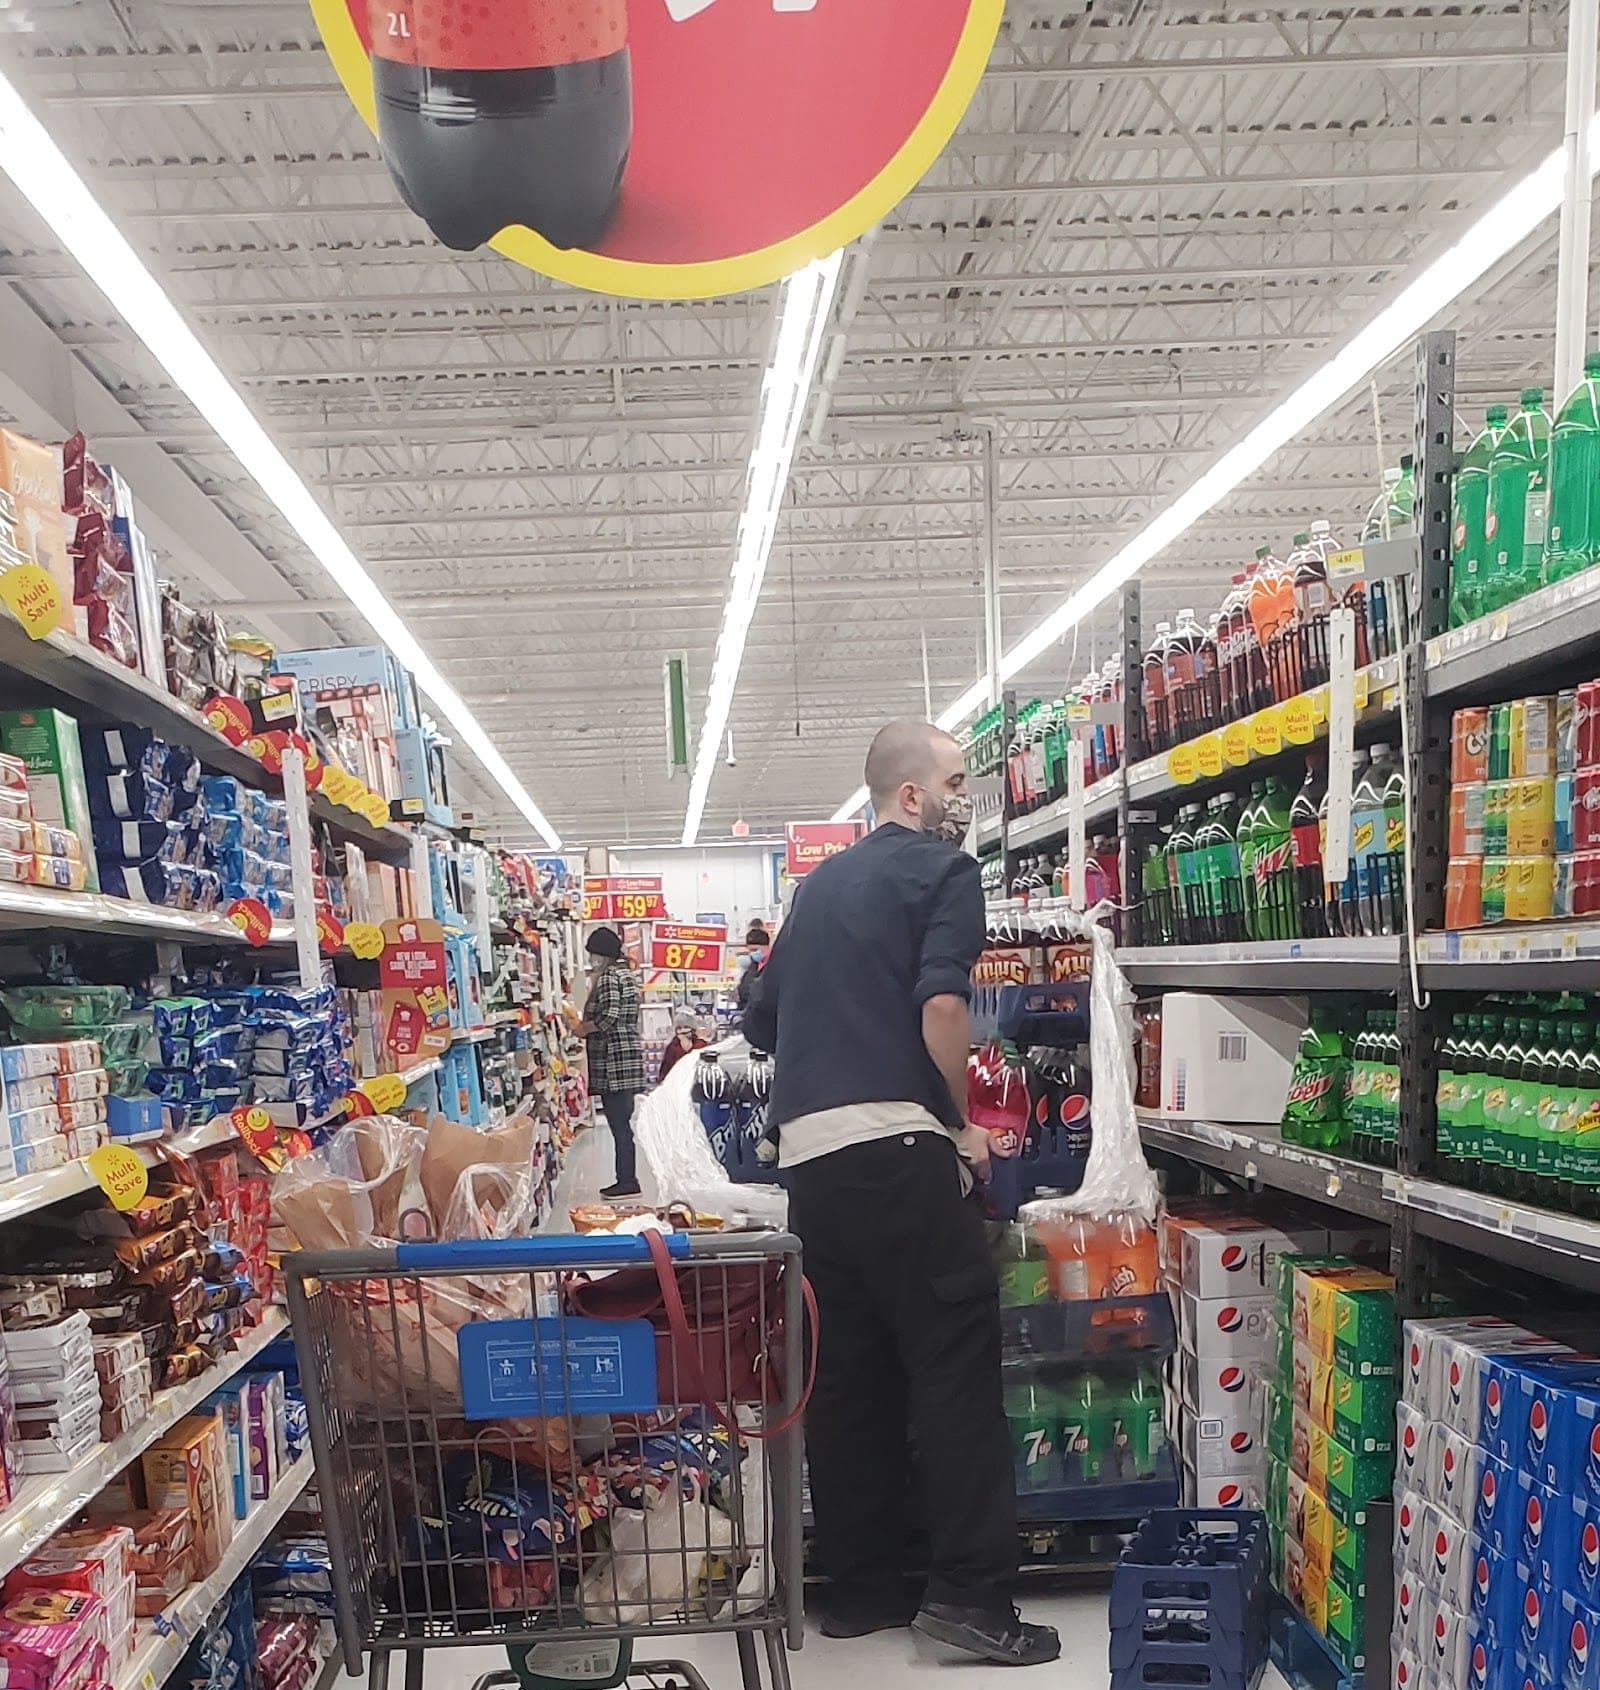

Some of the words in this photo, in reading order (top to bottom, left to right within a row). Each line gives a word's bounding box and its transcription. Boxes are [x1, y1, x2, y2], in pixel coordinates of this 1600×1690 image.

[387, 12, 410, 37] 2L
[17, 579, 50, 610] Multi
[26, 596, 56, 622] Save
[299, 674, 358, 692] CRISPY
[216, 698, 249, 738] Rollback
[1286, 713, 1310, 725] Multi
[1255, 726, 1278, 737] Multi
[1287, 724, 1309, 735] Save
[1227, 738, 1246, 748] Multi
[1256, 735, 1277, 746] Save
[1198, 749, 1219, 760] Multi
[1228, 747, 1246, 757] Save
[1172, 758, 1193, 769] Multi
[1199, 759, 1219, 768] Save
[1174, 767, 1193, 776] Save
[796, 844, 822, 855] Low
[678, 927, 692, 937] Low
[693, 928, 717, 937] Prices
[975, 960, 1025, 983] MUG
[1054, 956, 1091, 981] MU
[233, 1112, 263, 1157] Rollback
[106, 1159, 138, 1184] Multi
[114, 1175, 143, 1196] Save
